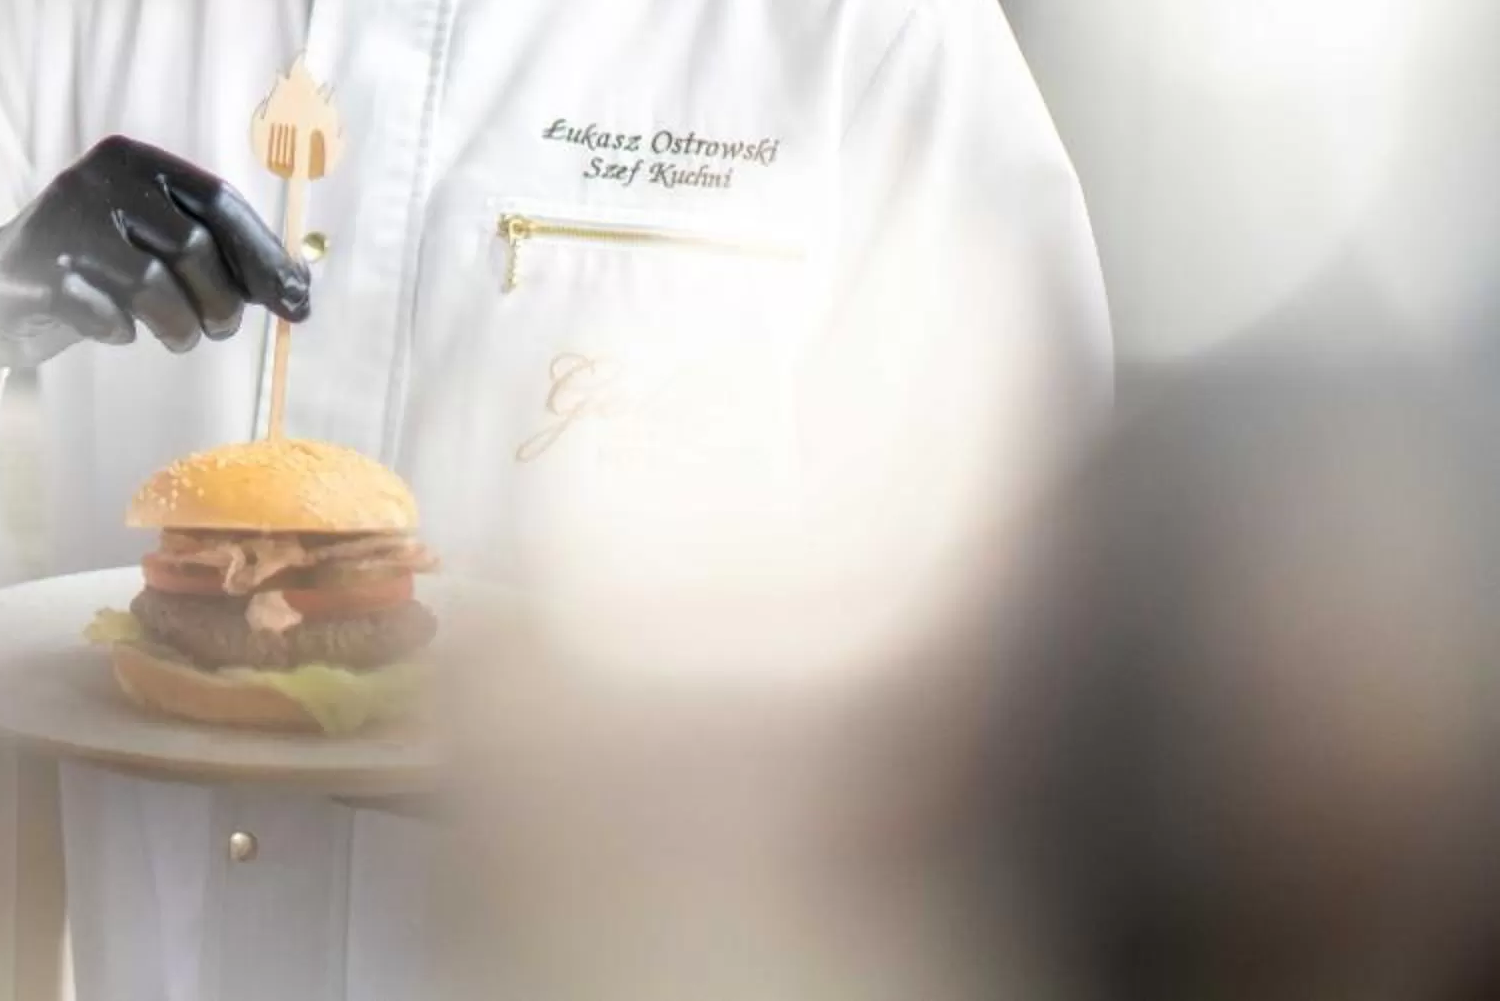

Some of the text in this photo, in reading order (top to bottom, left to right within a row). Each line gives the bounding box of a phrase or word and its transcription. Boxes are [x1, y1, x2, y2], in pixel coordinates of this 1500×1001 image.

[542, 118, 779, 166] Łukasz Ostrowski
[583, 156, 734, 189] Szef Kuchni
